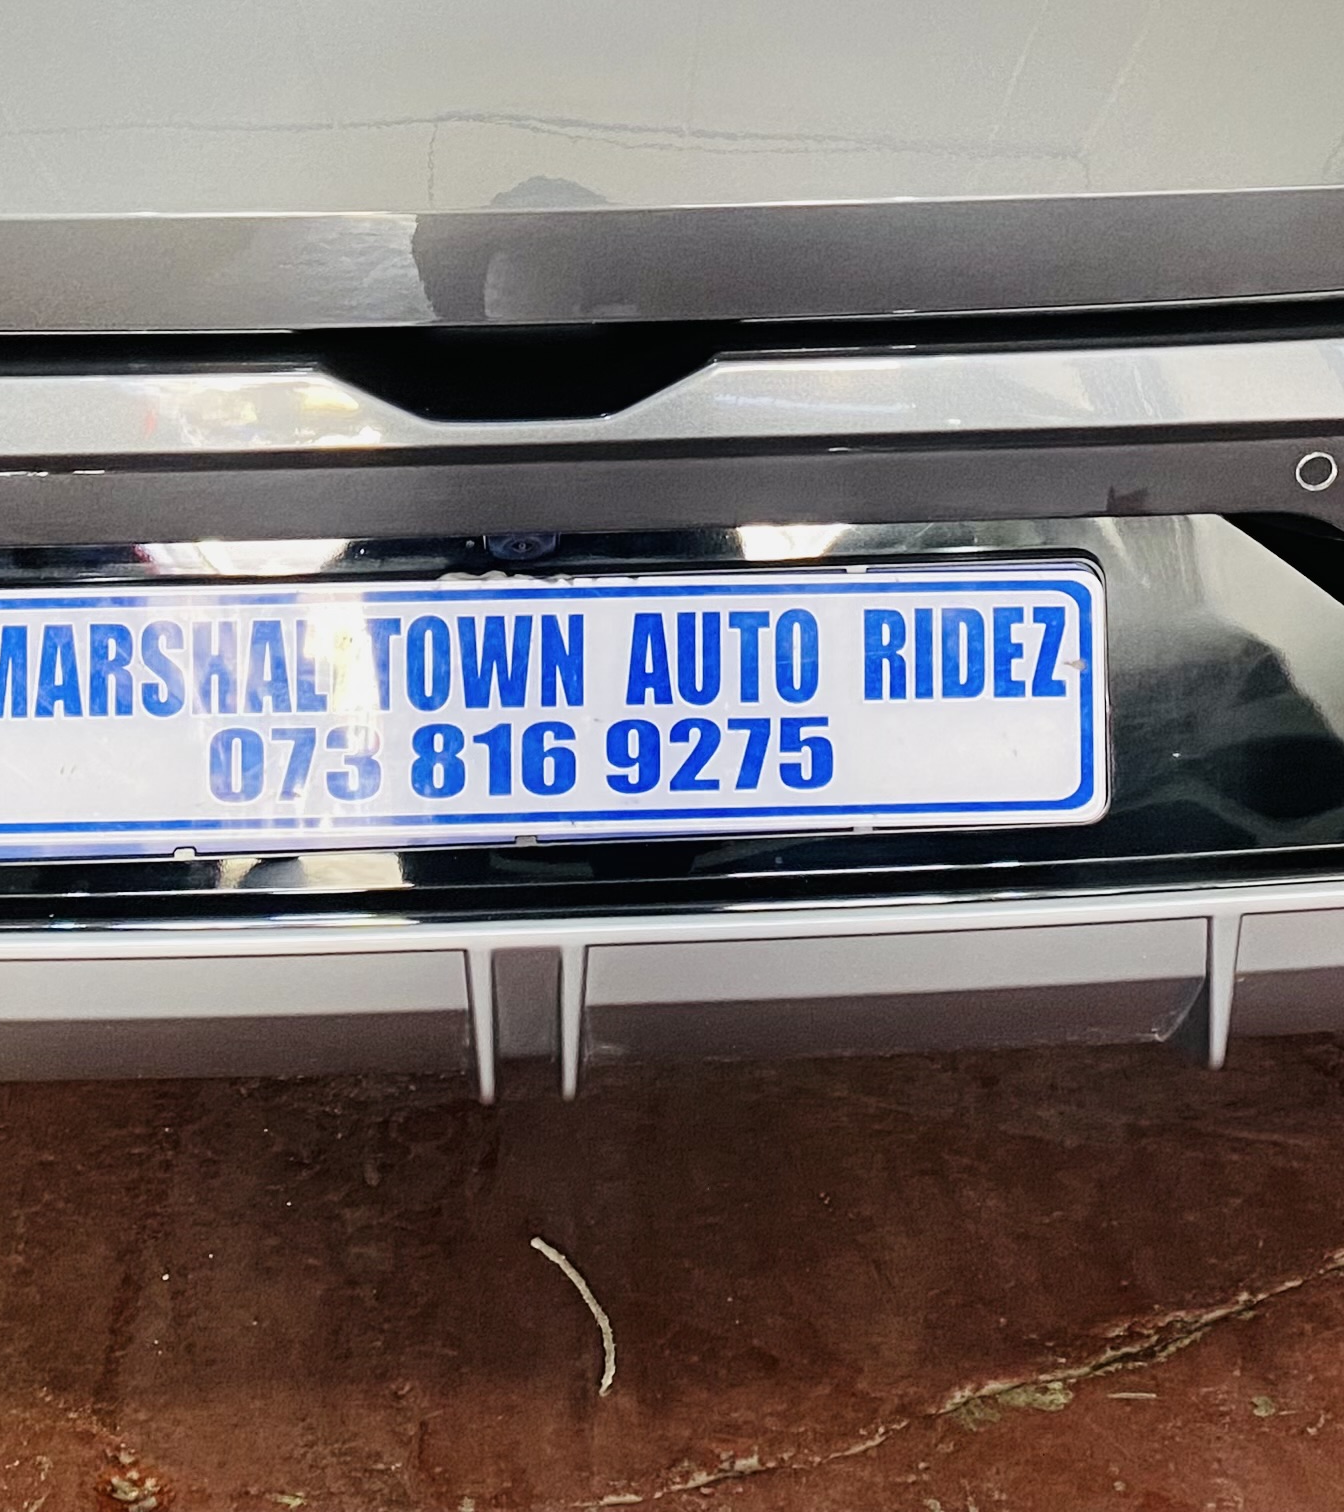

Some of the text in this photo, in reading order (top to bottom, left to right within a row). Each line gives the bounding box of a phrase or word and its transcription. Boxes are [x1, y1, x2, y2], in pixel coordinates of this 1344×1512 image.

[626, 608, 819, 705] AUTO
[863, 606, 1068, 700] RIDEZ
[209, 716, 834, 802] 073 816 9275
